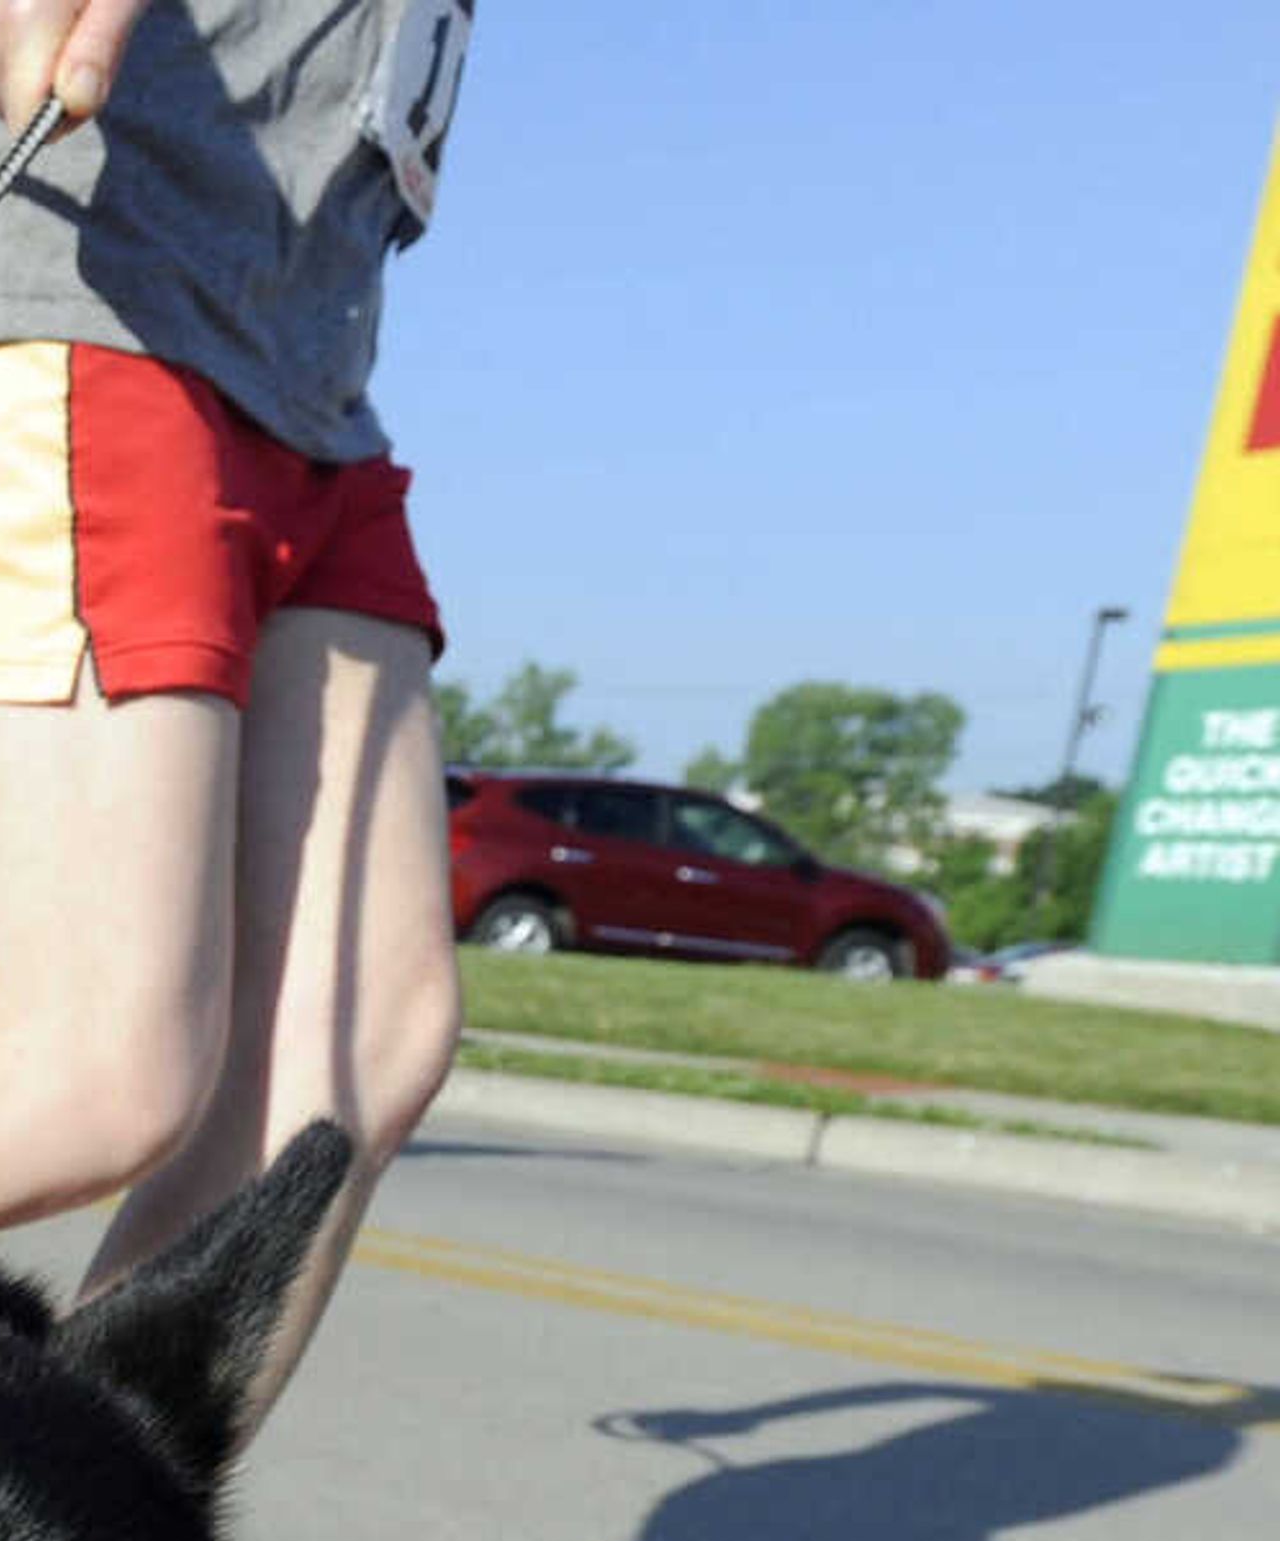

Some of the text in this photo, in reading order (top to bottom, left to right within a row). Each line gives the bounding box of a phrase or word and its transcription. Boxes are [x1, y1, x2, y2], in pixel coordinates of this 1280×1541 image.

[1202, 708, 1276, 748] THE
[1135, 796, 1280, 838] CHANG
[1141, 841, 1277, 883] ARTIST
